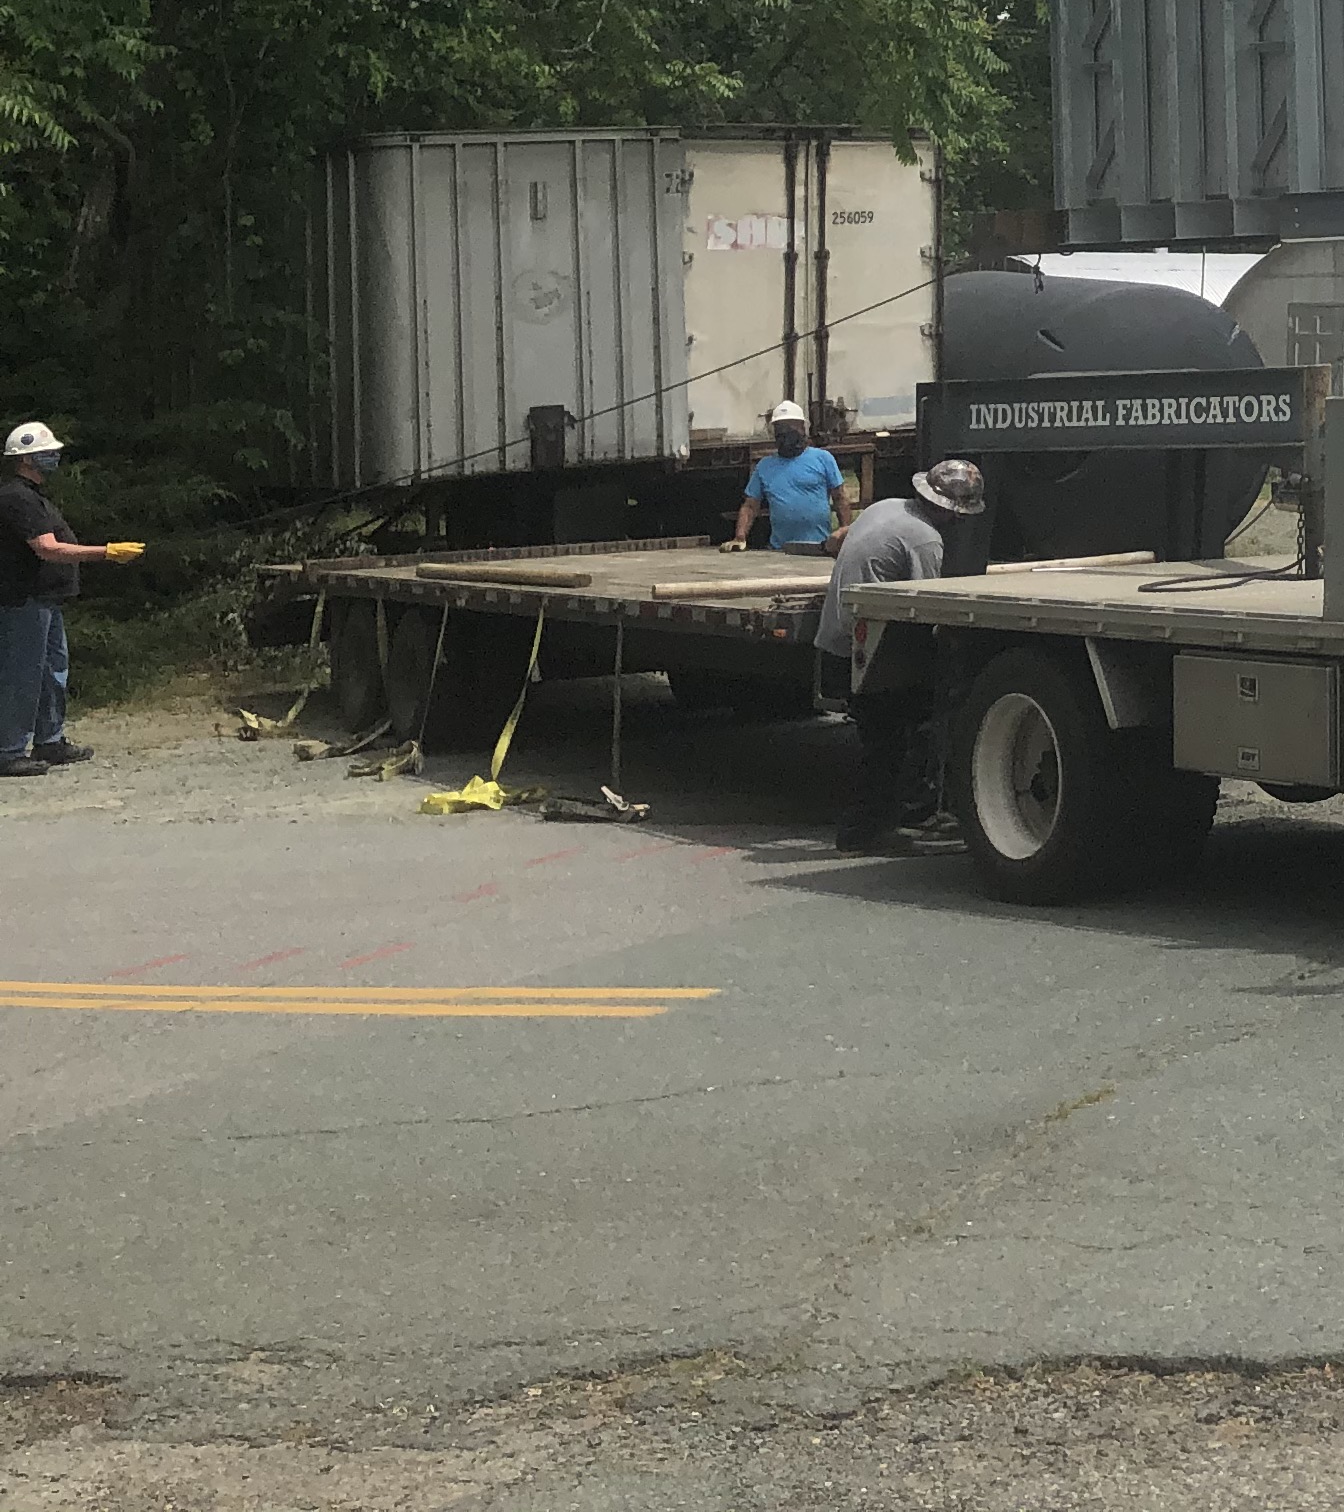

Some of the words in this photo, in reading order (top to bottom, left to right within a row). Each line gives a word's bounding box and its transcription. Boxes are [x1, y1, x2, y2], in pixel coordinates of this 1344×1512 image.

[831, 211, 874, 225] 256059
[969, 400, 1110, 429] INDUSTRIAL
[1115, 394, 1292, 426] FABRICATORS
